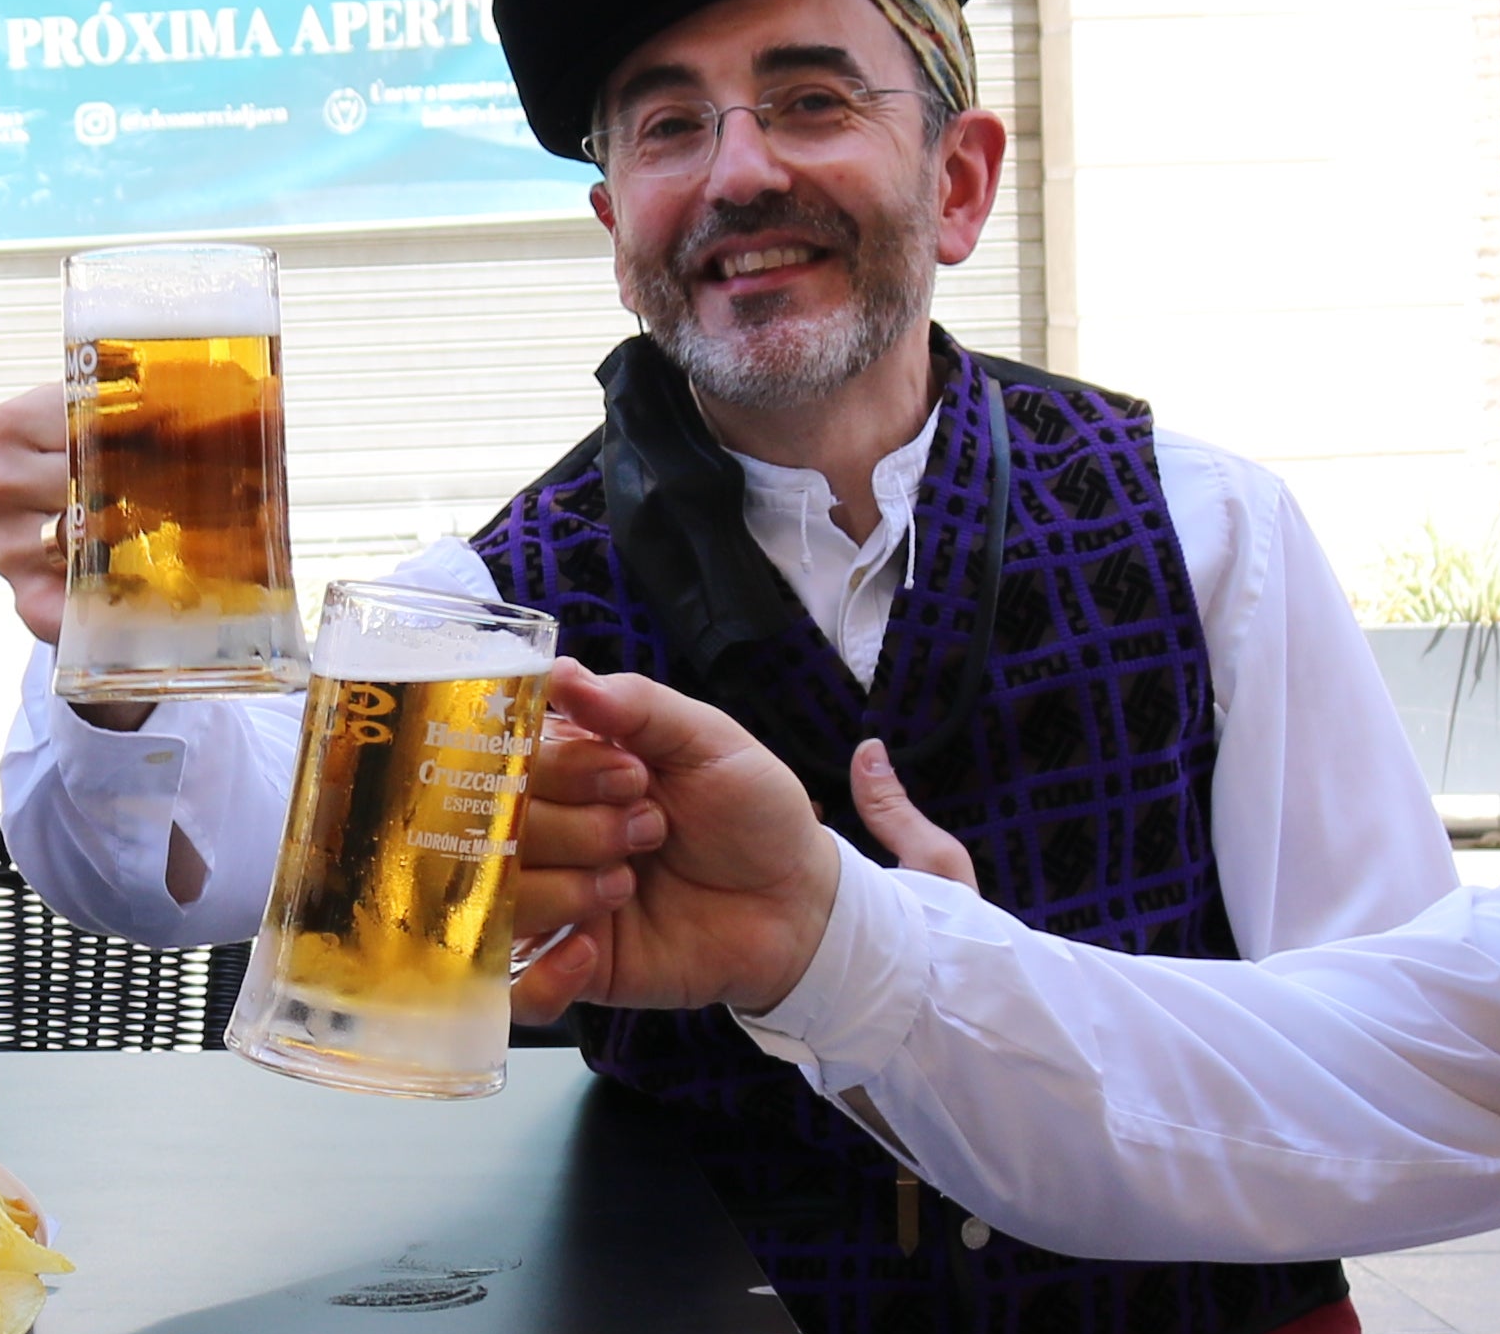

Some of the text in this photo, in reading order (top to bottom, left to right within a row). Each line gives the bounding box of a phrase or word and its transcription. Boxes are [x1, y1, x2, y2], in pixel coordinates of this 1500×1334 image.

[6, 2, 283, 71] PRÓXIMA
[424, 720, 533, 756] Heineken
[407, 829, 459, 854] LADRÓN
[459, 840, 473, 854] DE
